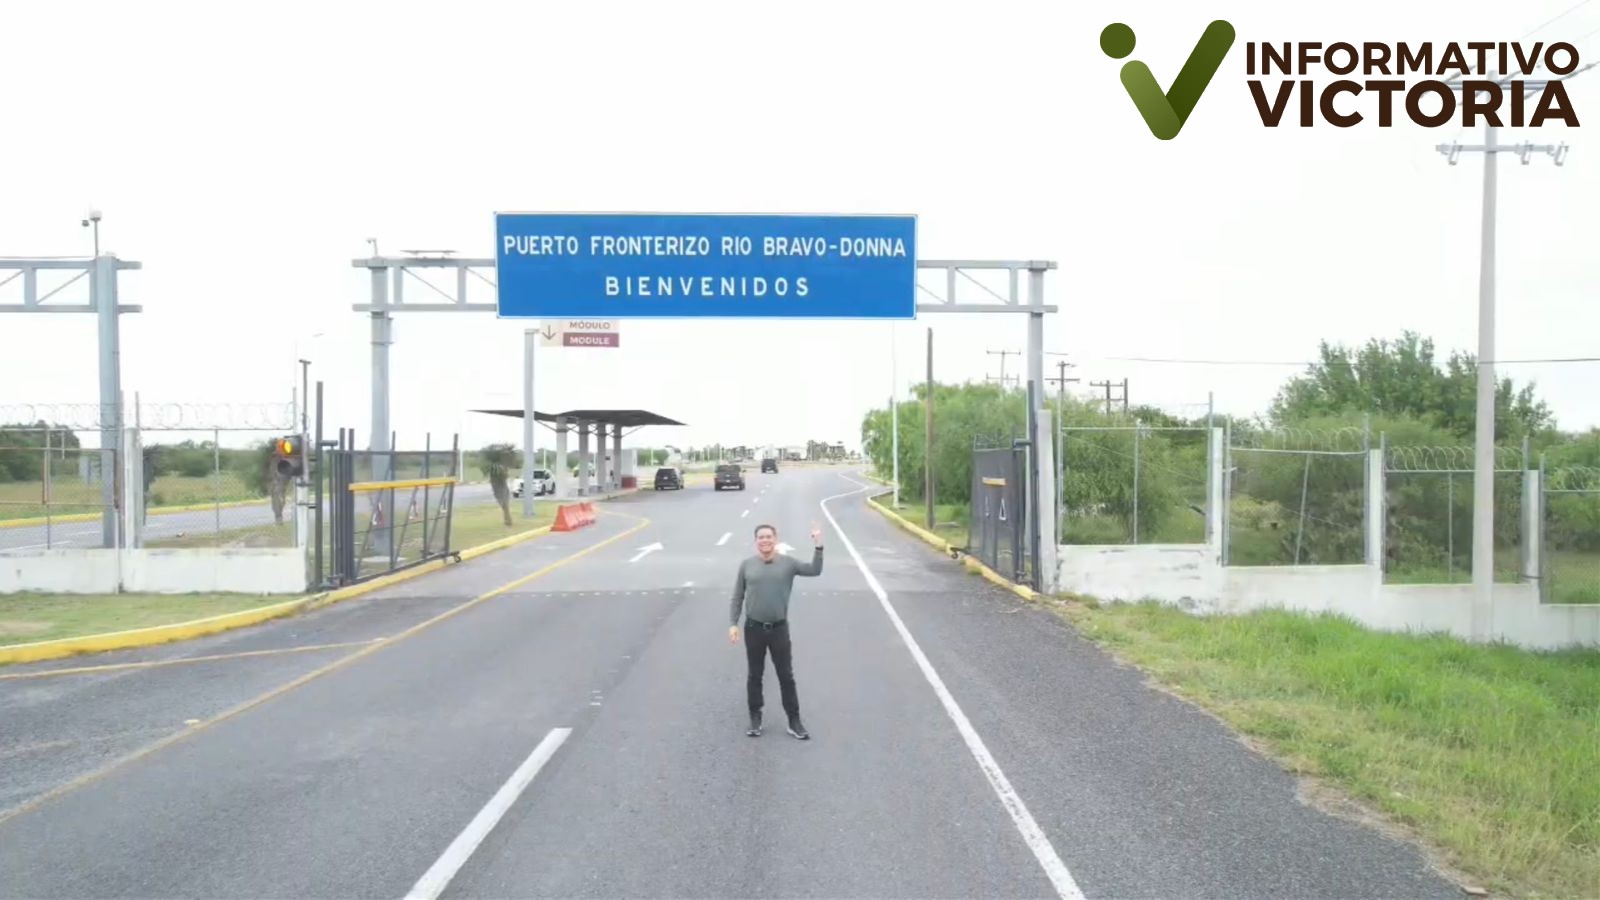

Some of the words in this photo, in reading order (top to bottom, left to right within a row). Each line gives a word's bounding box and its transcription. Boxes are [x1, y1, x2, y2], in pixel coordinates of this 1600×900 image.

[503, 235, 579, 256] PUERTO
[590, 235, 710, 257] FRONTERIZO
[720, 236, 752, 256] RIO
[763, 236, 907, 257] BRAVO-DONNA
[604, 276, 810, 297] BIENVENIDOS
[569, 335, 611, 345] MODULE
